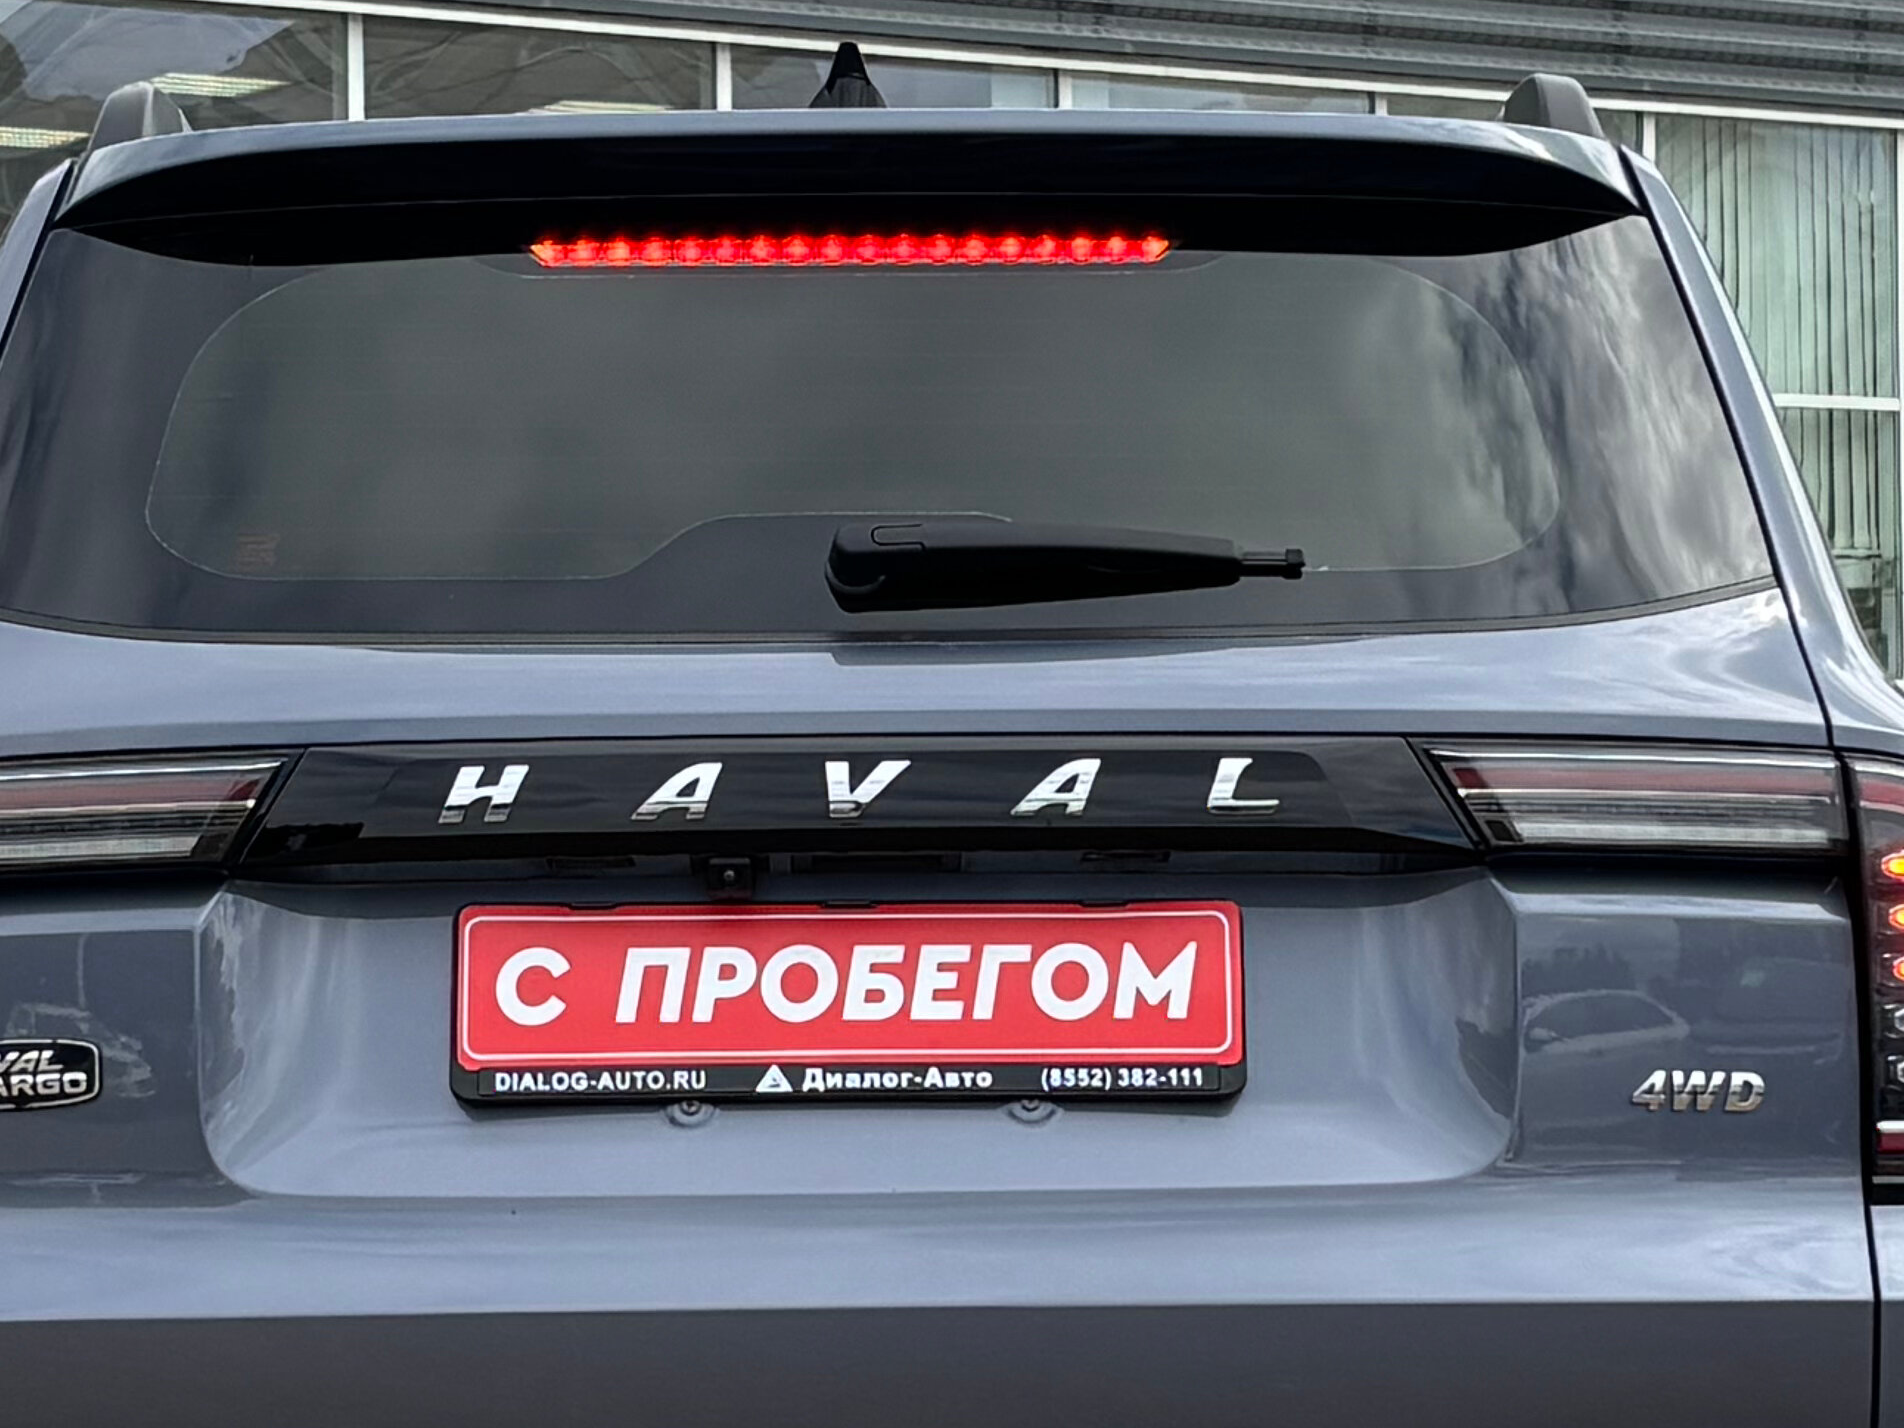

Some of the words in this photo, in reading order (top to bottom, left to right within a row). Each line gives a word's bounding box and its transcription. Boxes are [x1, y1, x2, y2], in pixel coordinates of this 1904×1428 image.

[436, 756, 1282, 824] HAVAL
[496, 946, 571, 1027] С
[614, 940, 1199, 1024] ПРОБЕГОМ
[494, 1070, 708, 1093] DIALOG-AUTO.RU
[801, 1066, 994, 1093] Диалог-Авто
[1040, 1066, 1112, 1091] (8552)
[1116, 1066, 1204, 1089] 382-111
[1631, 1069, 1766, 1113] 4WD
